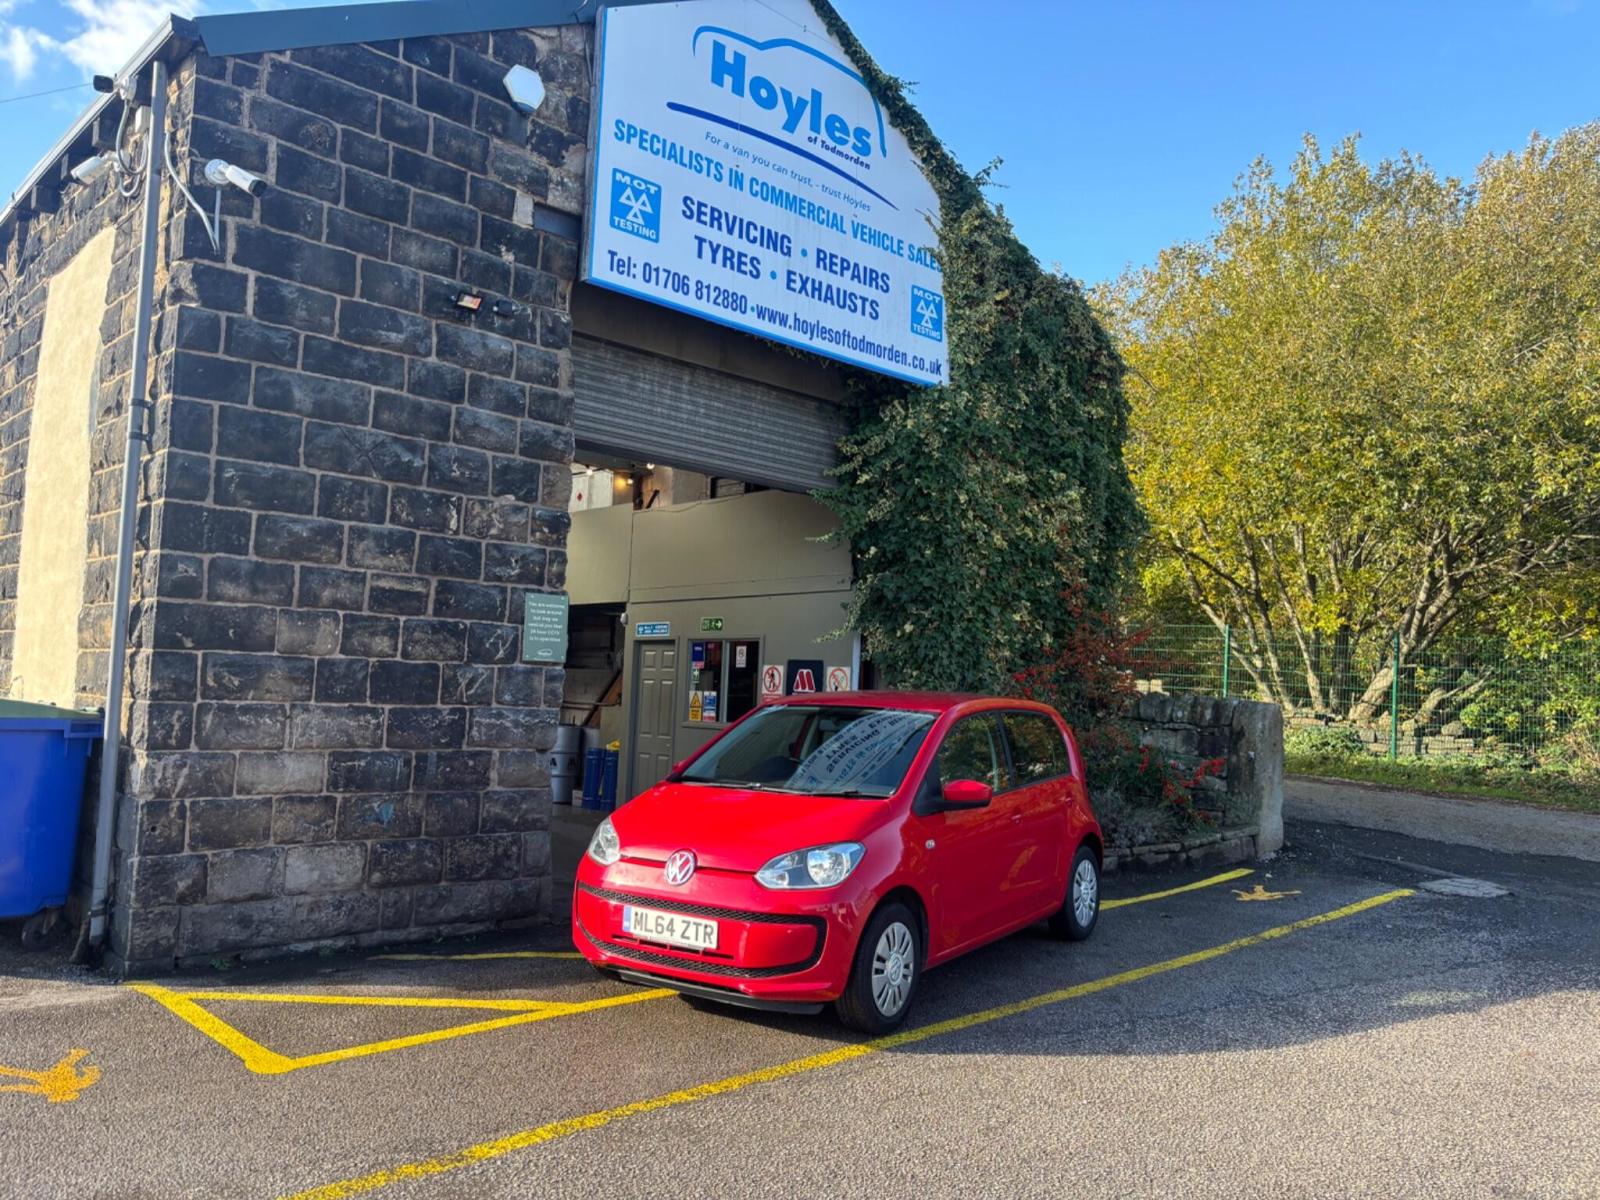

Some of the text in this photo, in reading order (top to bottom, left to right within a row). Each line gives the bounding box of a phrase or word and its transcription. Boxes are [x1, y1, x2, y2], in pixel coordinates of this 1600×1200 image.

[710, 39, 872, 158] Hoyles
[705, 131, 721, 146] For
[723, 141, 730, 150] a
[732, 145, 750, 159] van
[752, 153, 770, 168] you
[772, 163, 788, 176] can
[821, 184, 842, 199] trust
[843, 193, 872, 212] Hoyles
[807, 136, 871, 170] of Todmorden
[614, 119, 724, 183] SPECIALISTS
[728, 167, 744, 192] IN
[749, 177, 846, 235] COMMERCIAL
[851, 220, 904, 257] VEHICLE
[615, 171, 659, 195] MOT
[613, 216, 657, 240] TESTING
[681, 196, 890, 294] SERVICING REPAIRS
[694, 235, 880, 321] TYRES EXHAUSTS
[913, 288, 941, 303] MOT
[608, 250, 942, 376] Tel: 01706 812880 www.hoylesoftodmorden.co.uk
[912, 324, 941, 340] TESTING
[633, 911, 714, 945] ML64 ZTR
